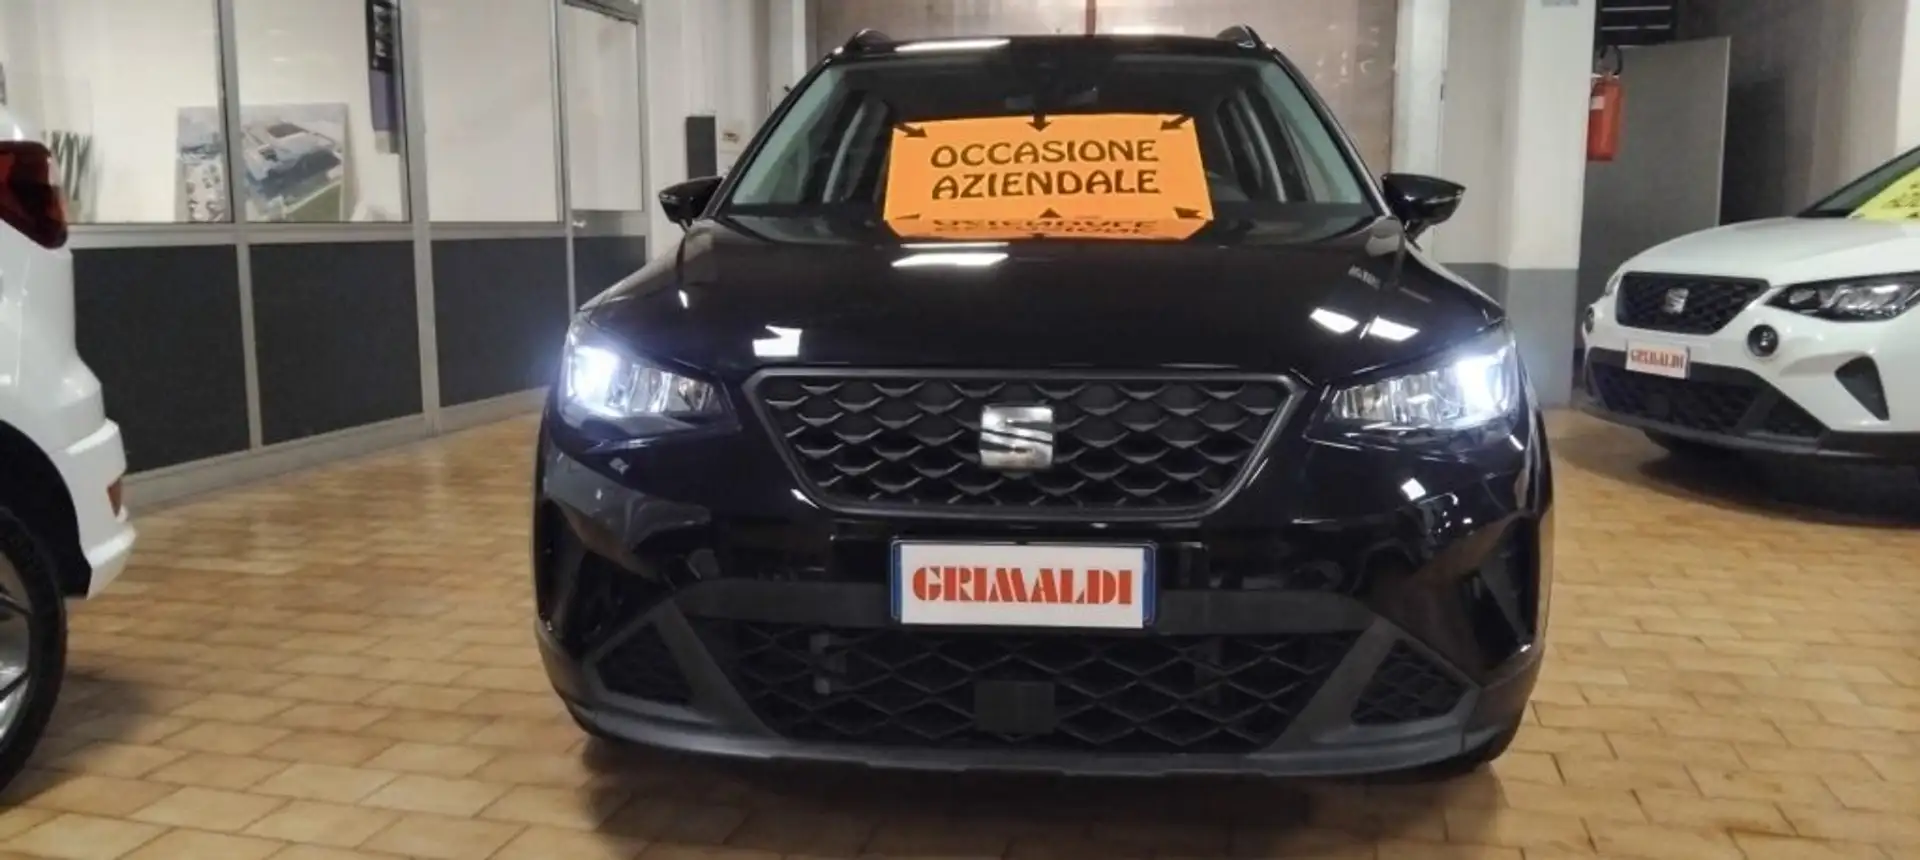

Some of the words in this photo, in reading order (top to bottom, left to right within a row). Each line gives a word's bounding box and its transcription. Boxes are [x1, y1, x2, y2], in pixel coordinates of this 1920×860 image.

[931, 140, 1159, 168] OCCASIONE
[932, 169, 1161, 200] AZIENDALE
[912, 566, 1132, 604] GRIMALDI
